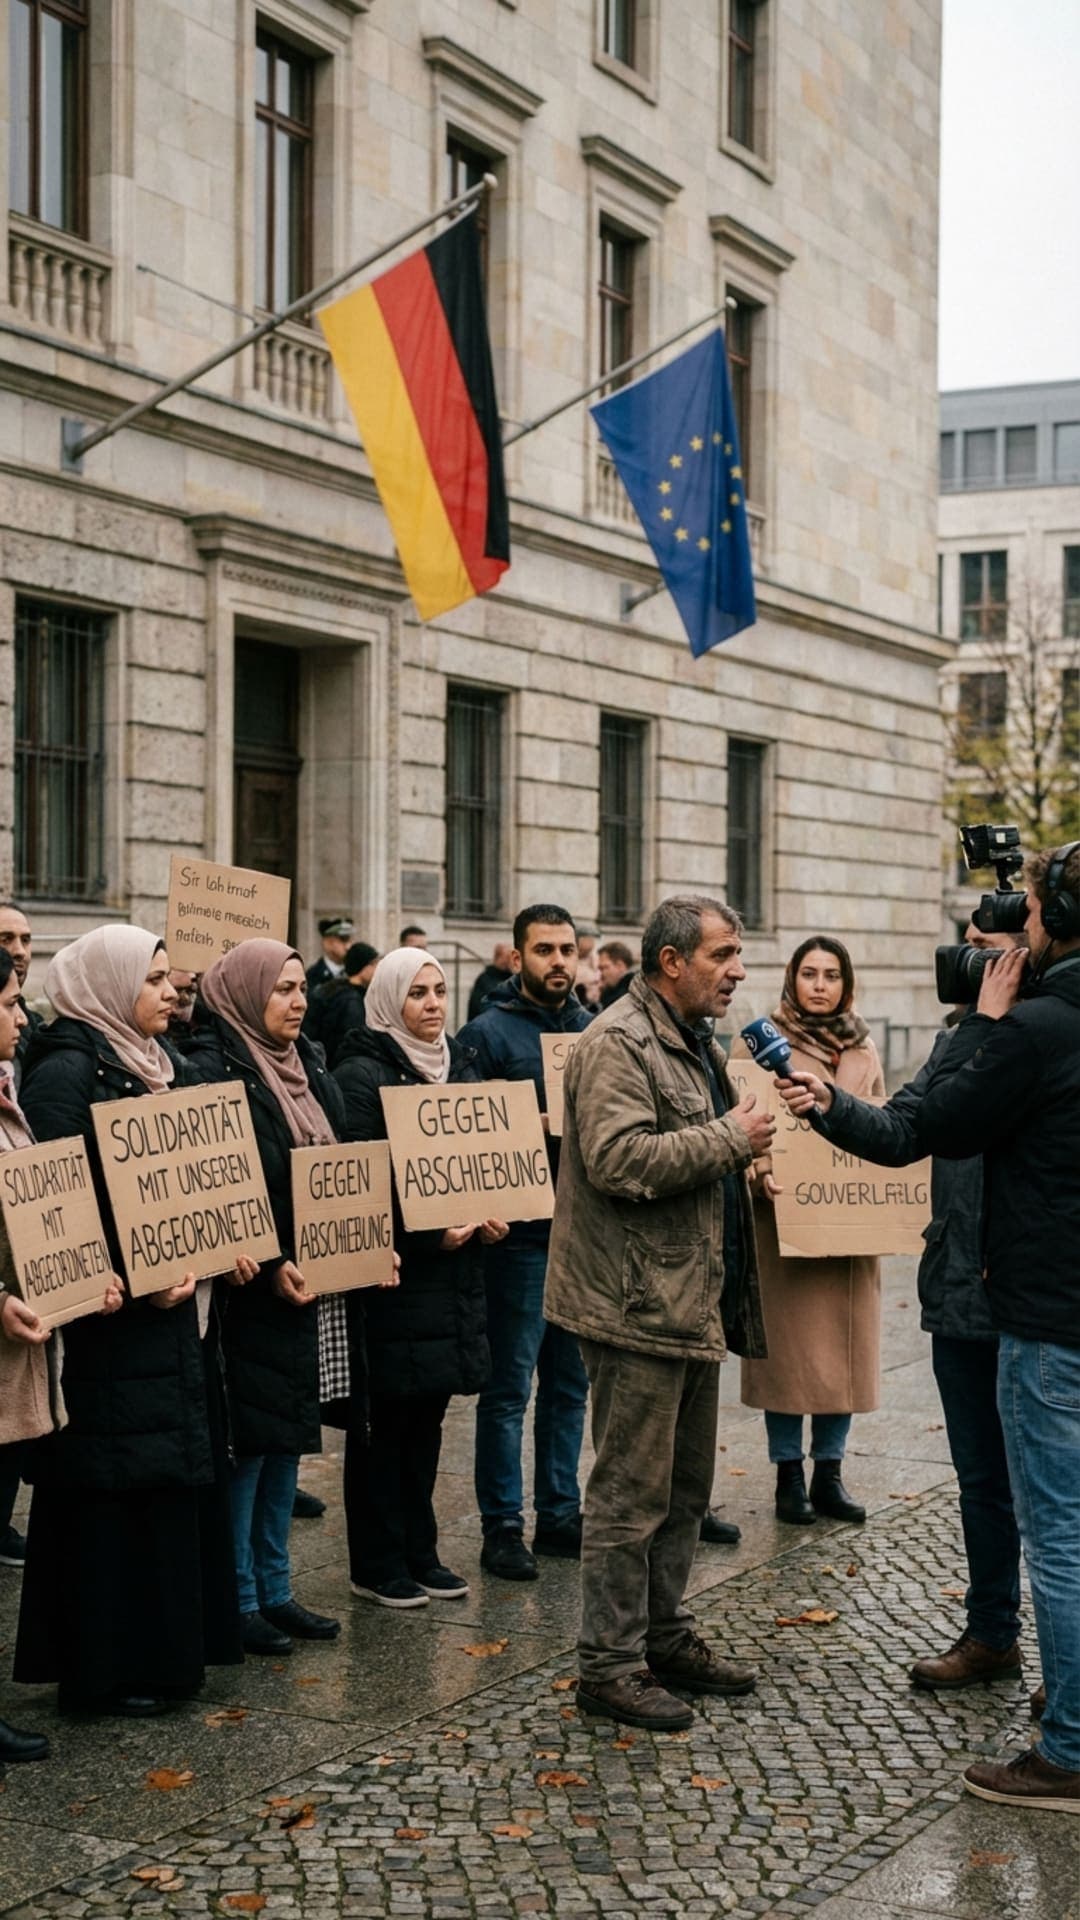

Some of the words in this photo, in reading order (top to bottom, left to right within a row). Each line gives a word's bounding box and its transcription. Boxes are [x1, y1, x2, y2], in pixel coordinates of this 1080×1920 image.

[110, 1096, 245, 1163] SOLIDARITÄT
[418, 1095, 510, 1137] GEGEN
[137, 1168, 170, 1204] MIT
[176, 1152, 251, 1196] UNSEREN
[309, 1158, 370, 1200] GEGEN
[404, 1148, 548, 1199] ABSCHIEBUNG
[41, 1206, 65, 1240] MIT
[131, 1196, 274, 1271] ABGEORDNETEN
[299, 1213, 391, 1262] ABSCHIEBUNG
[23, 1239, 111, 1300] ABGEORDNETEN
